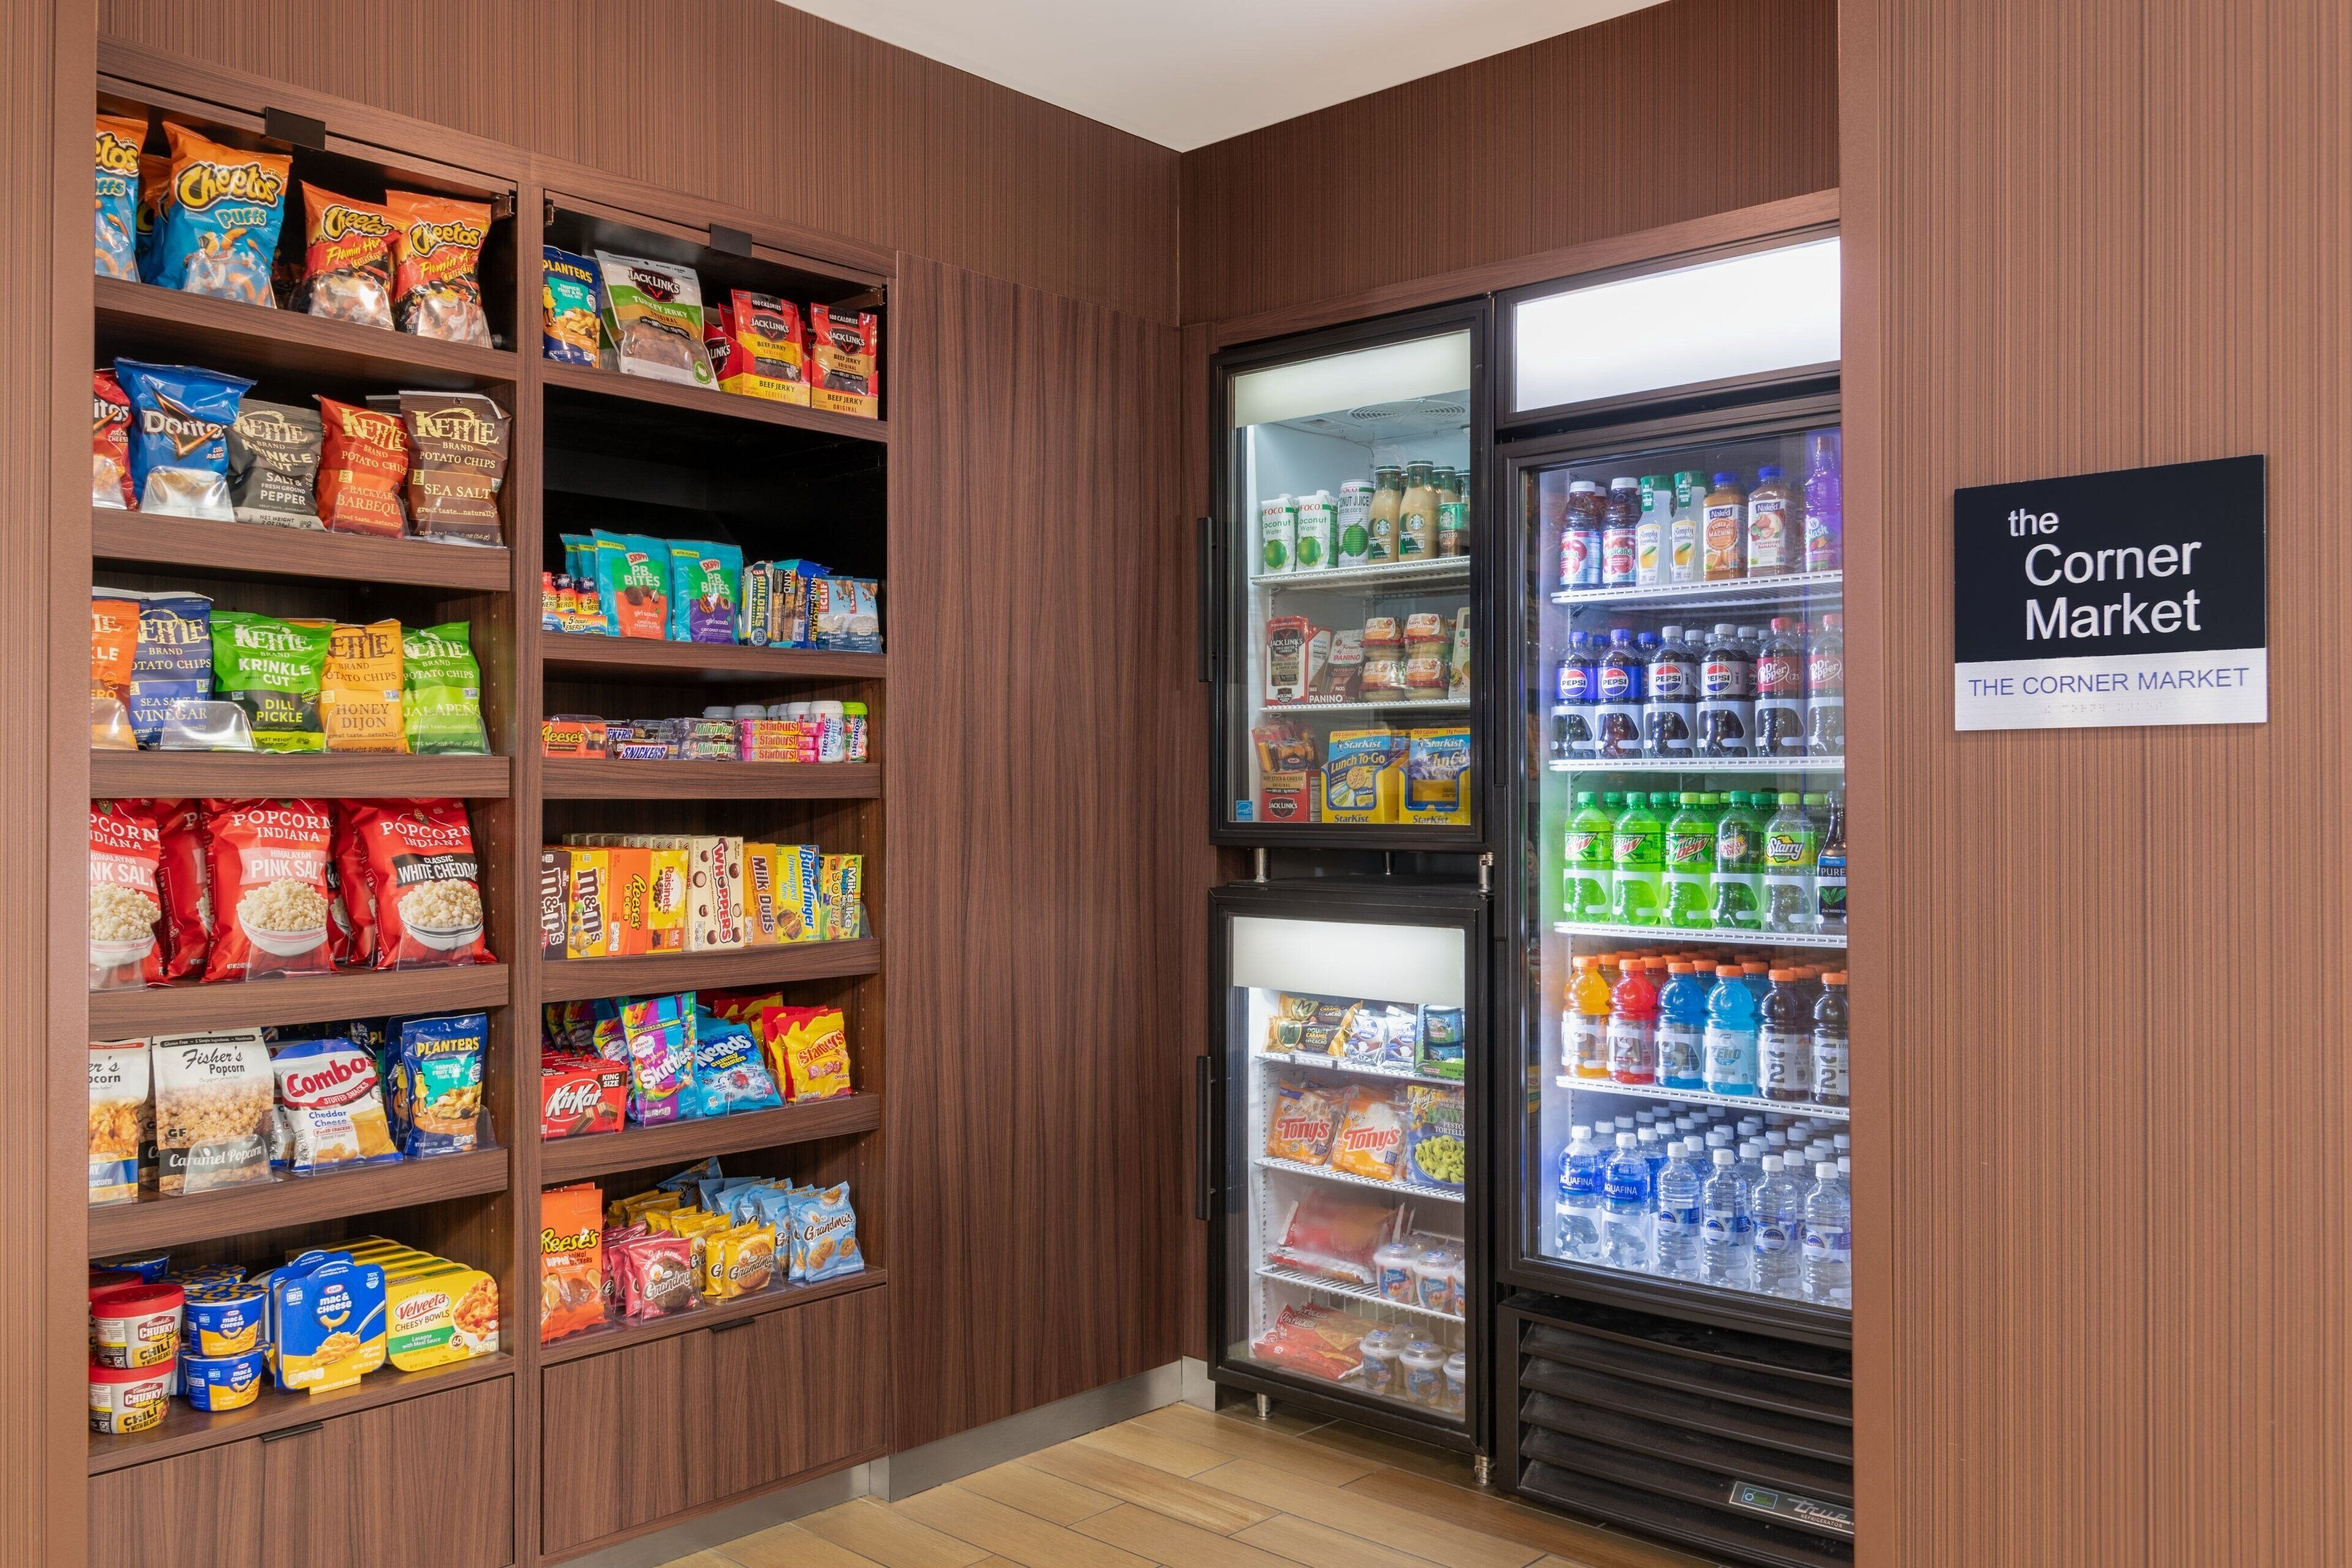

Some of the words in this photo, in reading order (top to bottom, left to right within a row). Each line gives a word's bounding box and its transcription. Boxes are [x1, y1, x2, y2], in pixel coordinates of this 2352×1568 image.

[628, 270, 653, 286] JACK
[633, 295, 663, 313] TURKEY
[664, 307, 687, 318] JERKY
[761, 301, 782, 311] CALORIES
[751, 318, 770, 328] JACK
[837, 316, 858, 325] CALORIES
[829, 331, 846, 342] JACK
[827, 394, 842, 402] BEEF
[843, 397, 862, 405] JERKY
[833, 404, 857, 413] ORIGINAL
[337, 407, 409, 451] KETTLE
[411, 408, 499, 446] KETTLE
[257, 441, 285, 450] BRAND
[363, 445, 388, 458] BRAND
[443, 442, 473, 452] BRAND
[341, 451, 378, 467] POTATO
[382, 462, 406, 475] CHIPS
[420, 451, 461, 463] POTATO
[464, 457, 496, 469] CHIPS
[266, 472, 292, 485] SALT
[260, 490, 306, 505] PEPPER
[424, 483, 452, 496] SEA
[456, 486, 491, 499] SALT
[1264, 507, 1284, 515] FOCO
[2008, 508, 2059, 537] the
[2025, 541, 2202, 586] Corner
[624, 575, 660, 587] BITES
[701, 582, 730, 594] BITES
[2026, 589, 2201, 640] Market
[234, 624, 314, 651] KETTLE
[177, 659, 211, 669] CHIPS
[239, 658, 311, 676] KRINKLE
[366, 671, 397, 681] CHIPS
[404, 669, 443, 681] POTATO
[446, 669, 474, 678] CHIPS
[1655, 674, 1683, 684] PEPSI
[1968, 678, 2015, 696] THE
[2023, 673, 2128, 695] CORNER
[2138, 668, 2249, 690] MARKET
[141, 698, 165, 707] SEA
[265, 699, 294, 711] DILL
[1309, 695, 1343, 703] PANINO
[134, 708, 206, 723] VINEGAR
[337, 704, 389, 715] HONEY
[256, 711, 303, 723] PICKLE
[342, 717, 386, 731] DIJON
[1344, 739, 1382, 749] StarKist
[622, 747, 666, 759] SNICKERS
[1331, 755, 1357, 773] Lunch
[1334, 814, 1370, 823] StarKist
[257, 828, 321, 842] INDIANA
[403, 837, 464, 847] INDIANA
[1766, 837, 1804, 861] Starry
[424, 855, 453, 864] CLASSIC
[252, 860, 291, 878] PINK
[398, 864, 432, 883] WHITE
[752, 856, 768, 891] Milk
[663, 866, 674, 915] Raisinets
[800, 850, 814, 929] Butterfinger
[758, 894, 774, 934] Duds
[417, 1038, 480, 1057] PLANTERS
[183, 1046, 243, 1069] Fisher's
[209, 1064, 245, 1076] Popcorn
[324, 1089, 346, 1104] STUFFED
[347, 1082, 369, 1099] SNACKS
[309, 1110, 347, 1119] Cheddar
[168, 1128, 187, 1137] GF
[1277, 1118, 1330, 1140] Tony's
[1344, 1128, 1400, 1151] Tony's
[170, 1150, 225, 1167] Caramel
[228, 1145, 262, 1163] Popcorn
[1604, 1182, 1637, 1195] AQUAFINA
[804, 1212, 853, 1241] Grandma's
[541, 1228, 600, 1254] Reese's
[399, 1293, 446, 1319] Velveeta
[395, 1319, 423, 1332] CHEESY
[424, 1310, 450, 1324] BOWLS
[139, 1322, 175, 1335] CHUNKY
[452, 1336, 462, 1345] 60
[140, 1341, 170, 1360] CHILI
[146, 1355, 160, 1365] WITH
[158, 1351, 171, 1362] BEANS
[125, 1389, 163, 1404] CHUNKY
[124, 1408, 157, 1426] CHILI
[1801, 1514, 1842, 1528] REFRIGERATOR
